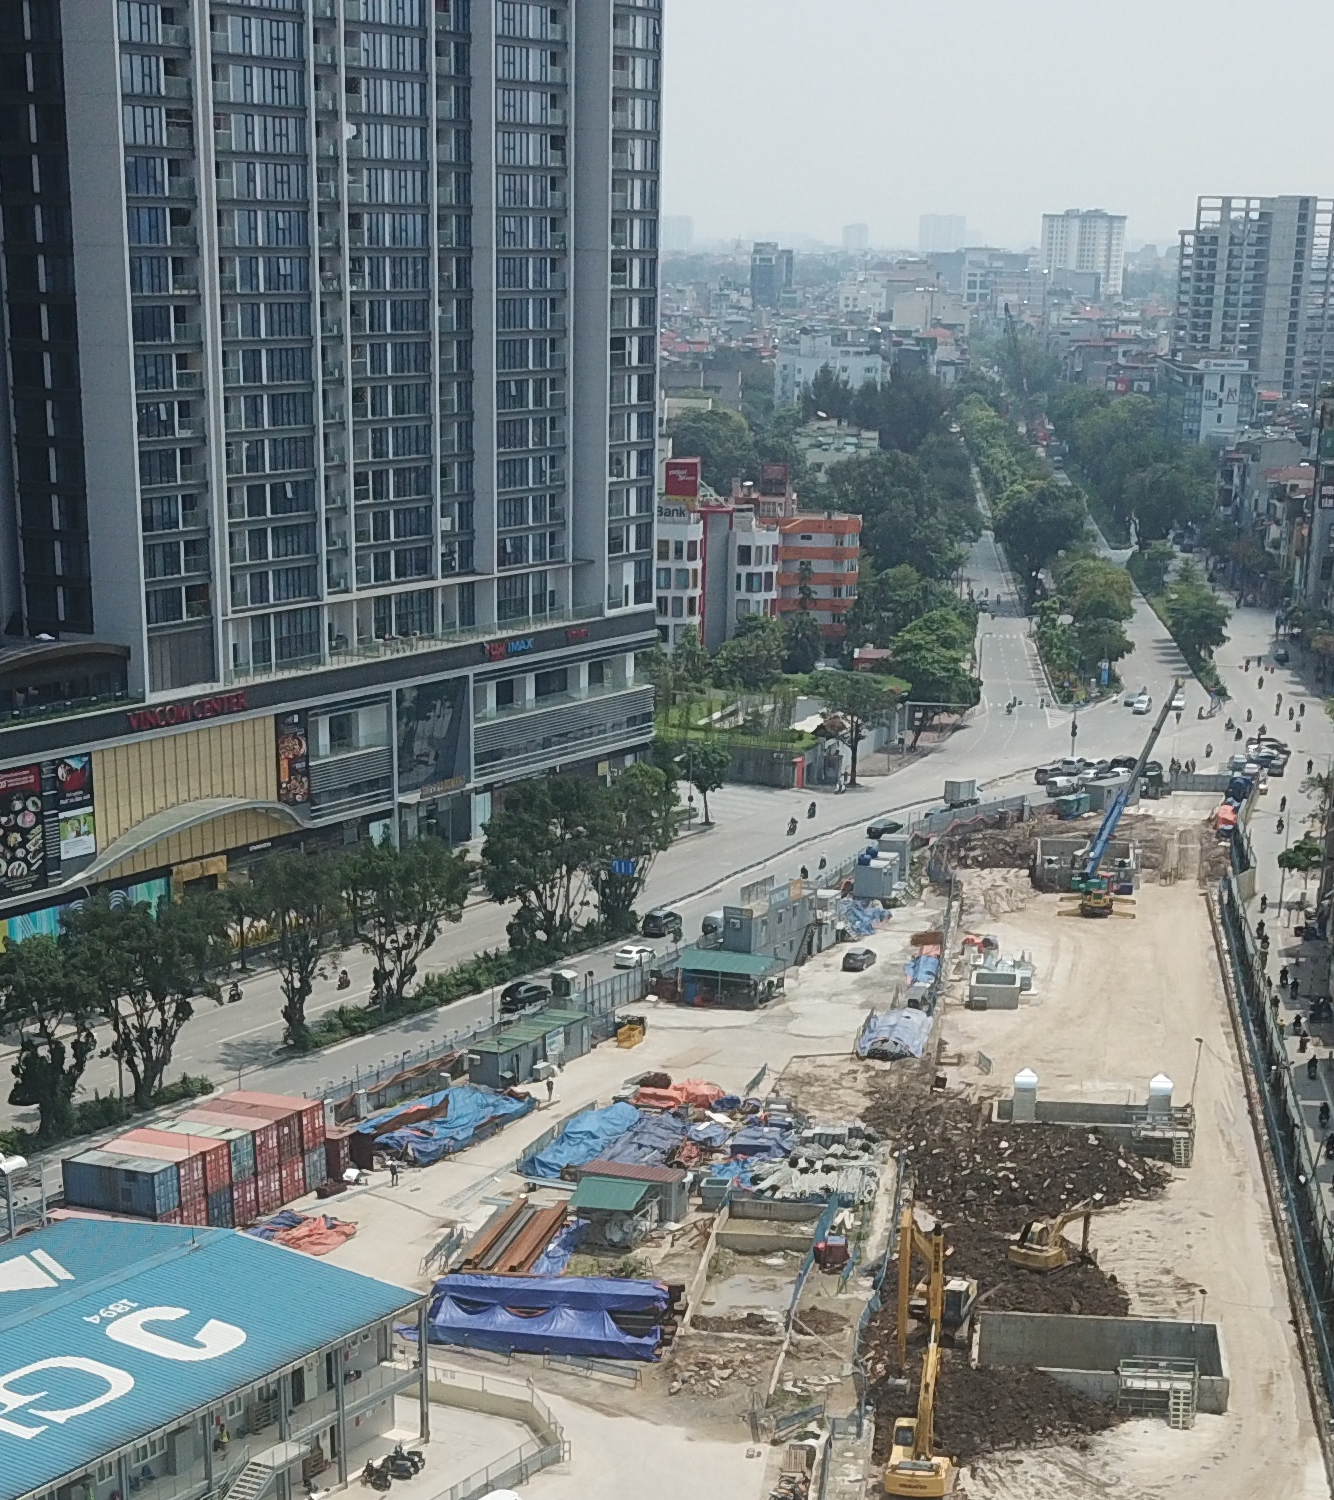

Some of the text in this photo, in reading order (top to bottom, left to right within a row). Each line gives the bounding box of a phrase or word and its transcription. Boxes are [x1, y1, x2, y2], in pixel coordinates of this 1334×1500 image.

[127, 691, 248, 730] VINCOM CENTER
[82, 1298, 140, 1325] 1894
